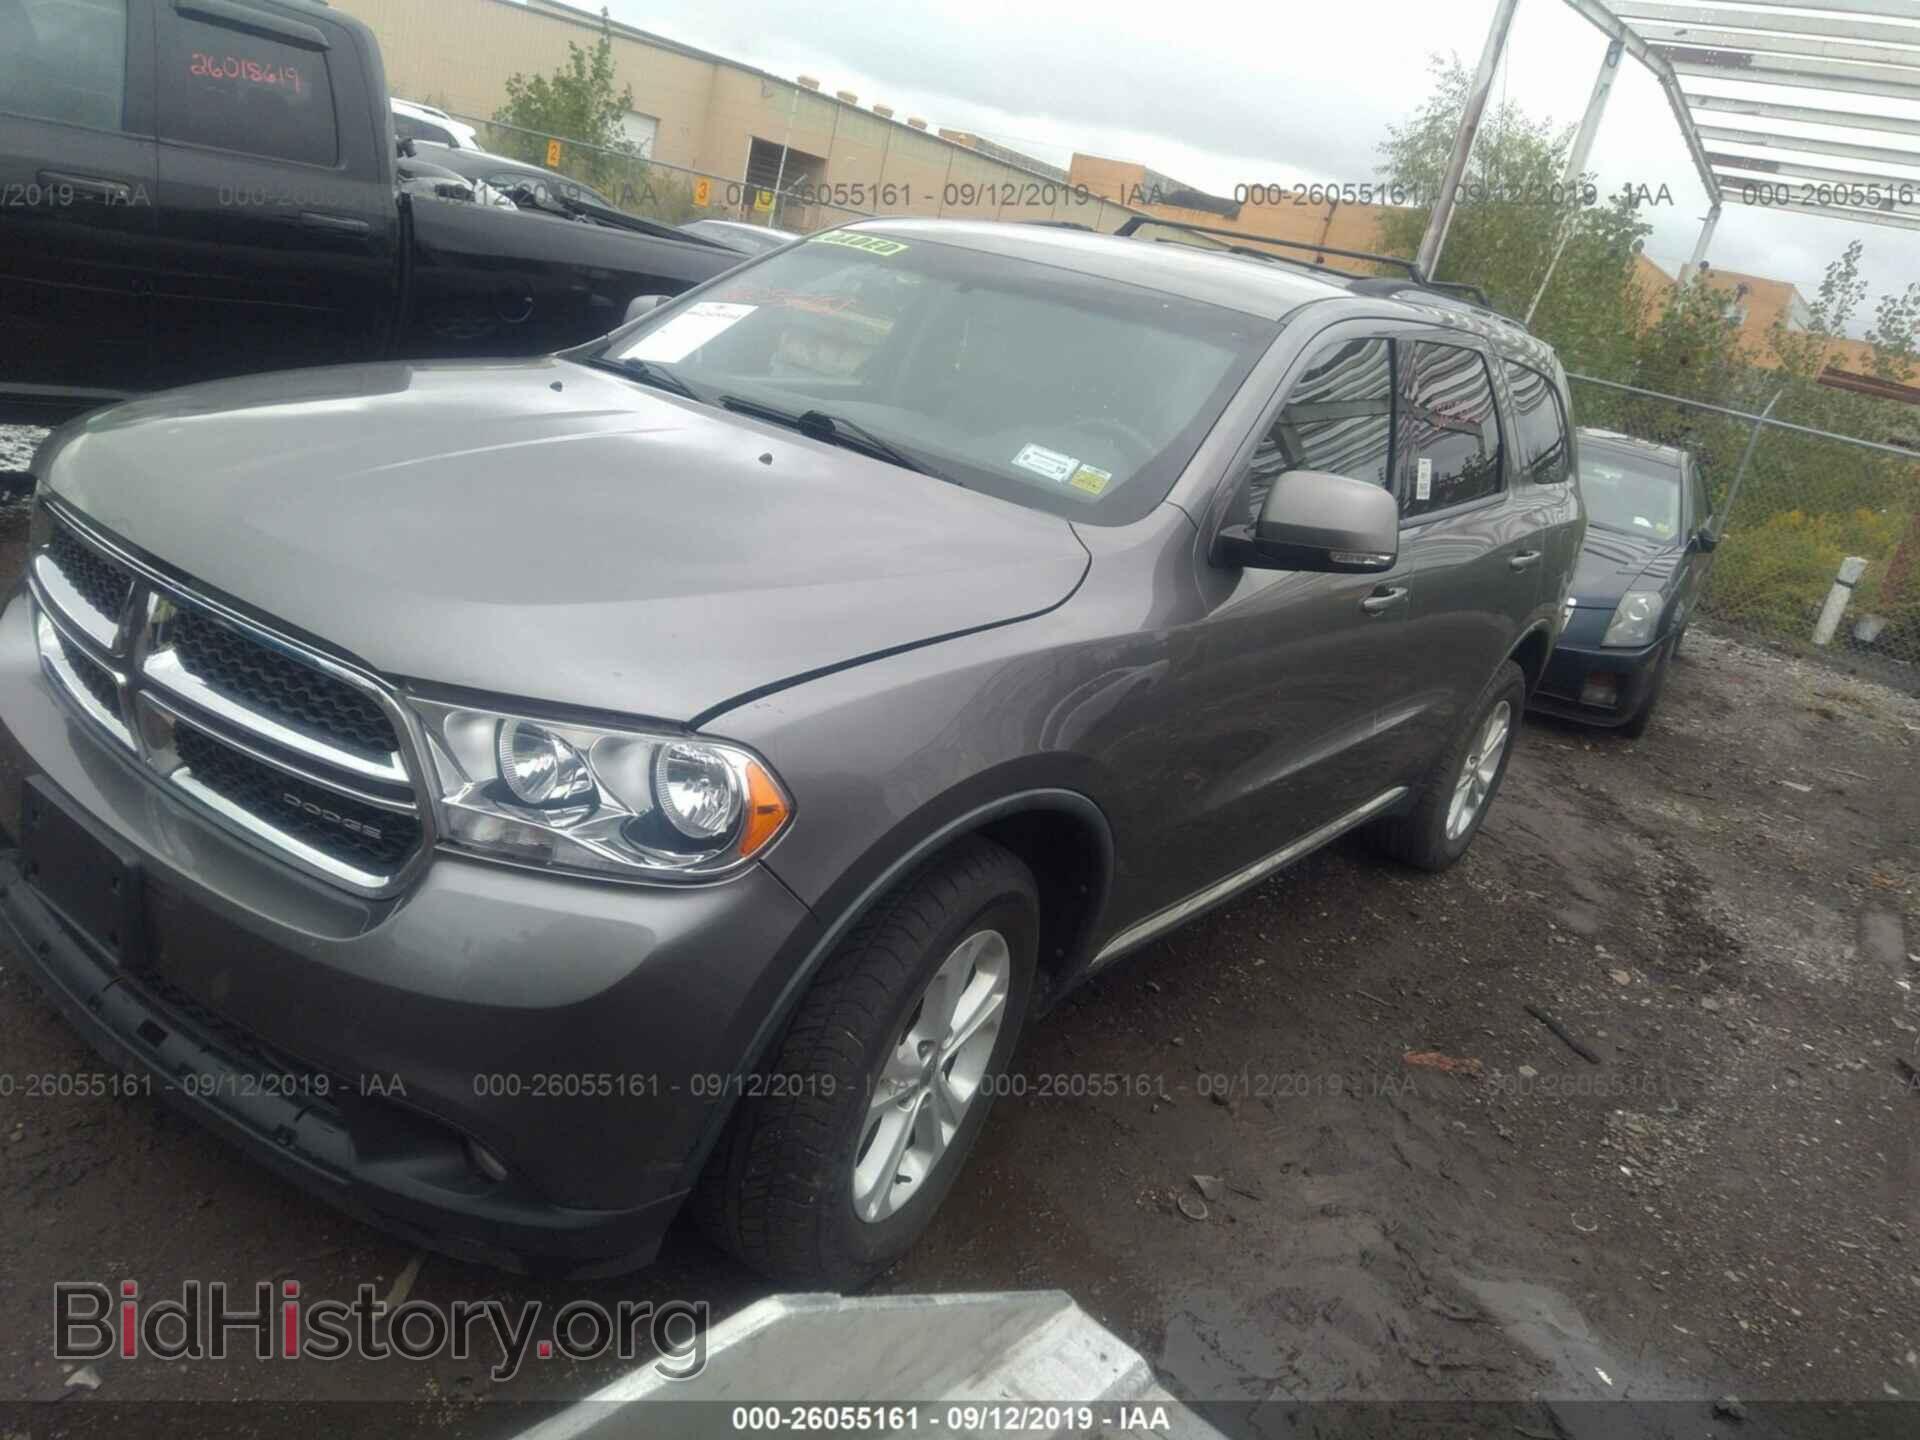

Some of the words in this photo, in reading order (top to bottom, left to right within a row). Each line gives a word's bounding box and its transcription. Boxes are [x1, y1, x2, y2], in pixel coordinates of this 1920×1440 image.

[550, 143, 558, 161] 2
[698, 181, 709, 199] 3
[283, 793, 382, 839] DODGE
